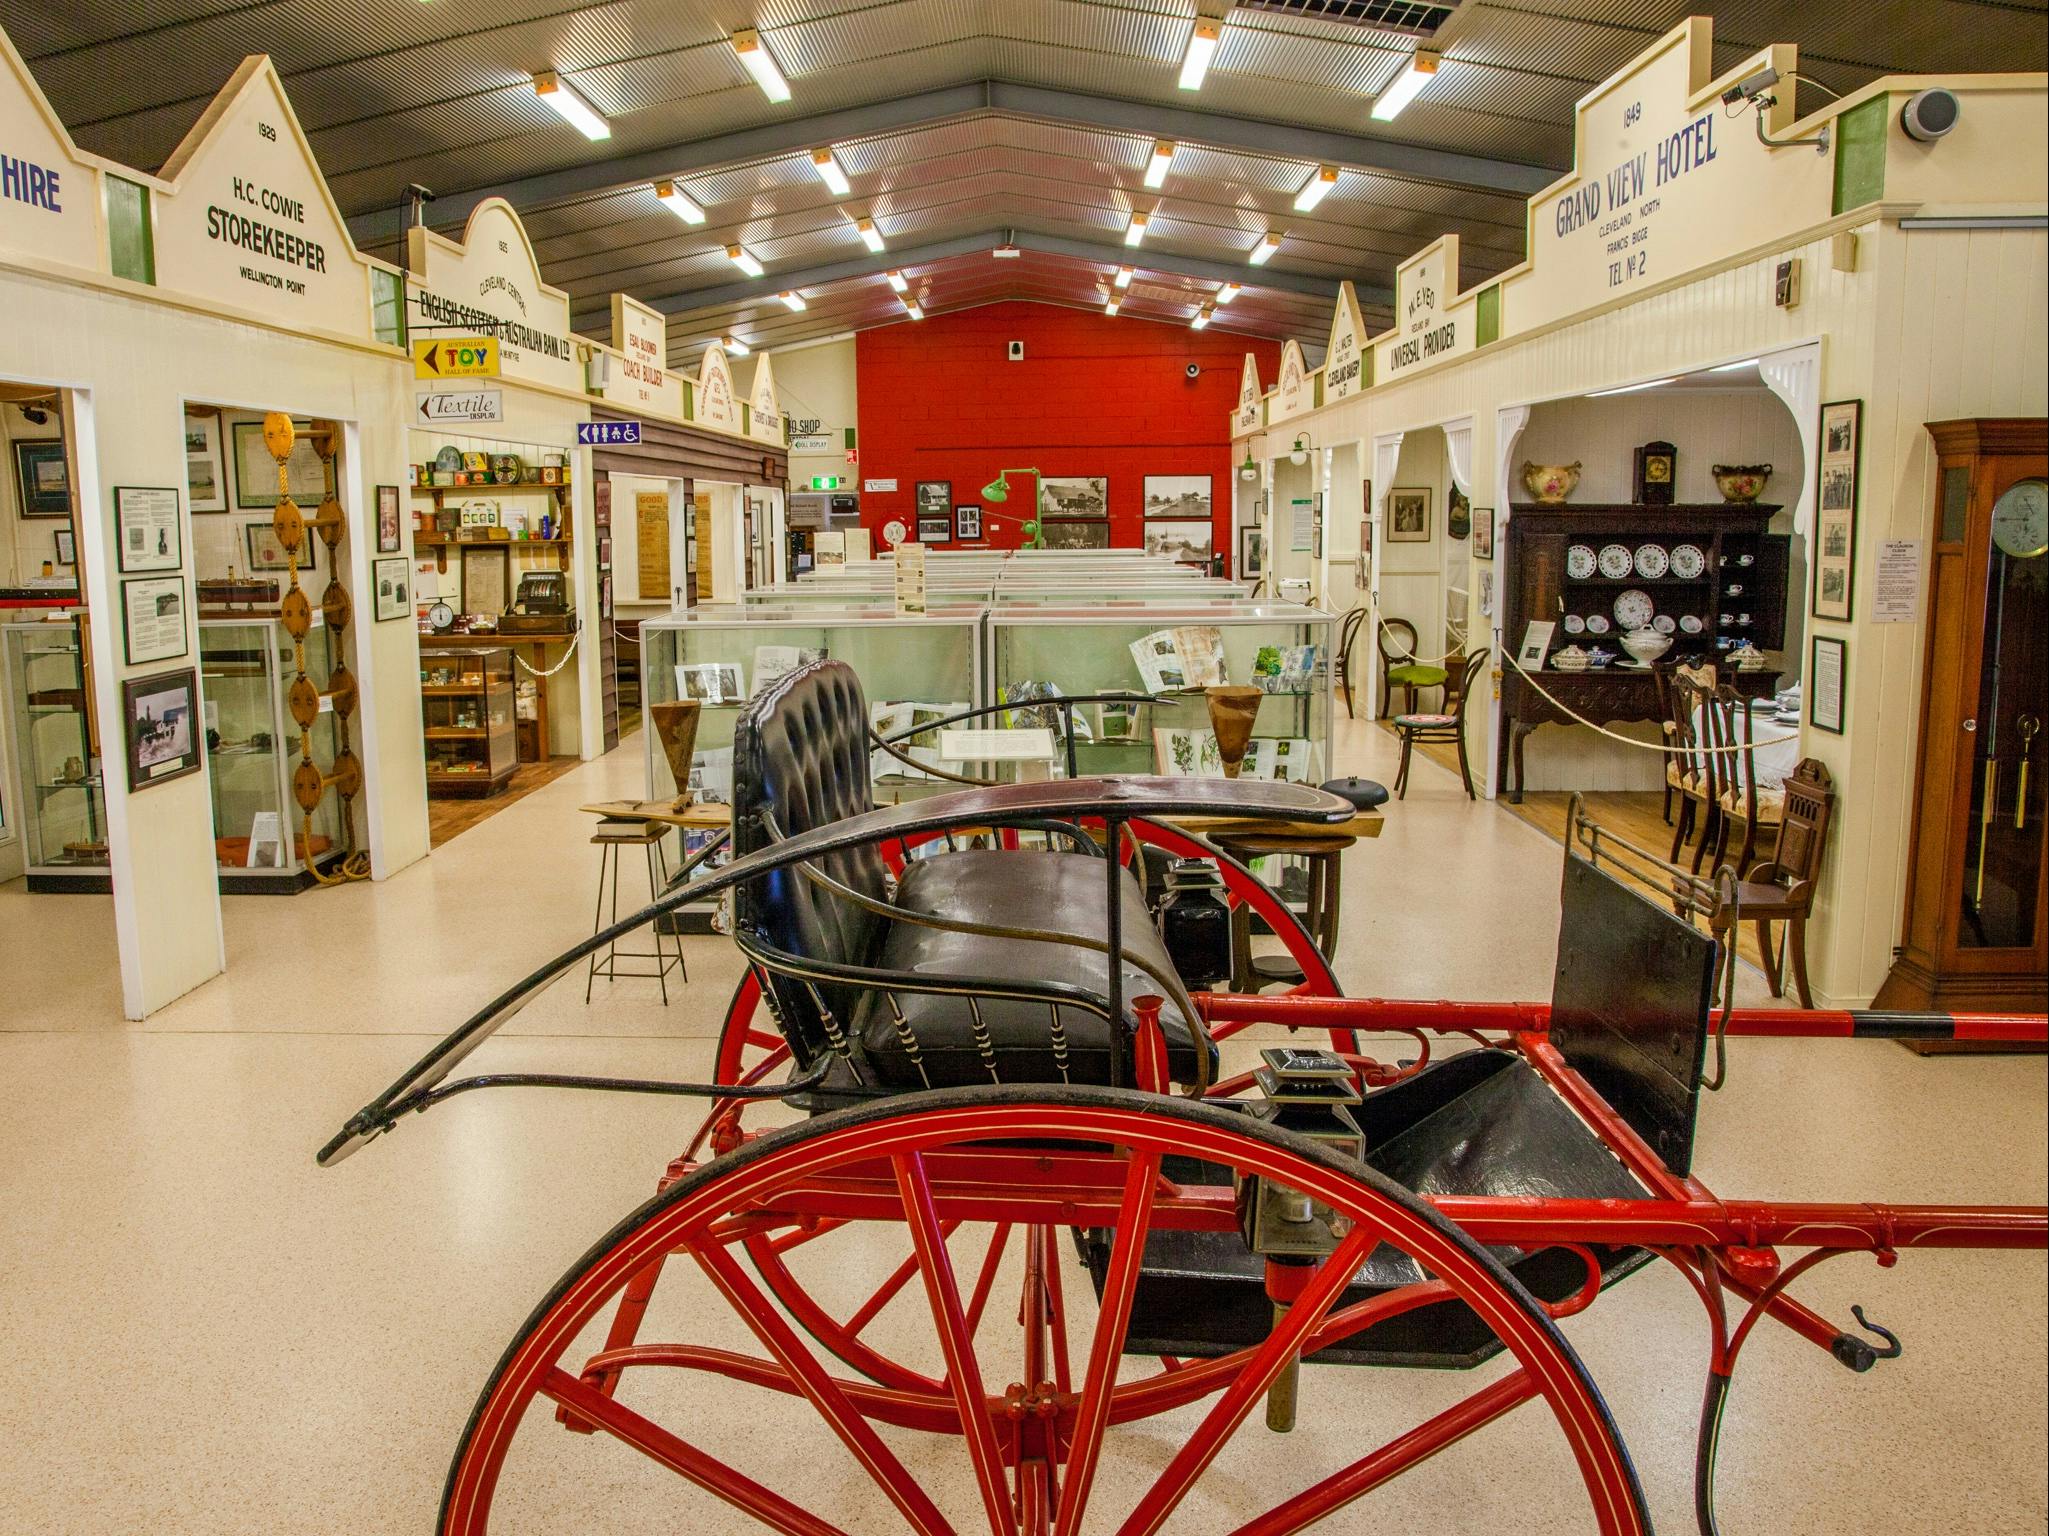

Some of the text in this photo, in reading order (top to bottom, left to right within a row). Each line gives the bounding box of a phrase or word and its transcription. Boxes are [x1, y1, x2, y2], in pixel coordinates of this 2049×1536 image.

[1623, 101, 1641, 129] 1849
[258, 121, 277, 142] 1929
[1, 154, 62, 214] HIRE
[1556, 113, 1718, 238] GRAND VIEW HOTEL
[233, 176, 304, 224] H.C. COWIE
[1599, 198, 1661, 238] CLEVELAND NORTH
[207, 205, 326, 274] STOREKEEPER
[1607, 226, 1648, 256] FRANCIS BIGGE
[239, 266, 306, 296] WELLINGTON POINT
[1609, 261, 1623, 288] TEL
[1638, 251, 1646, 275] 2
[479, 276, 527, 318] CLEVELAND CENTRAL
[1422, 287, 1435, 310] YEO
[420, 290, 457, 327] ENGLISH
[459, 304, 499, 337] SCOTTISH
[505, 320, 543, 354] AUSTRALIAN
[543, 333, 560, 359] BANK
[560, 338, 571, 362] LTD
[445, 348, 488, 368] TOY
[1390, 322, 1455, 371] UNIVERSAL PROVIDER
[623, 358, 663, 387] COACH BUILDER
[431, 394, 493, 413] Textile
[469, 412, 496, 420] DISPLAY
[799, 419, 821, 433] SHOP
[640, 496, 663, 504] GOOD
